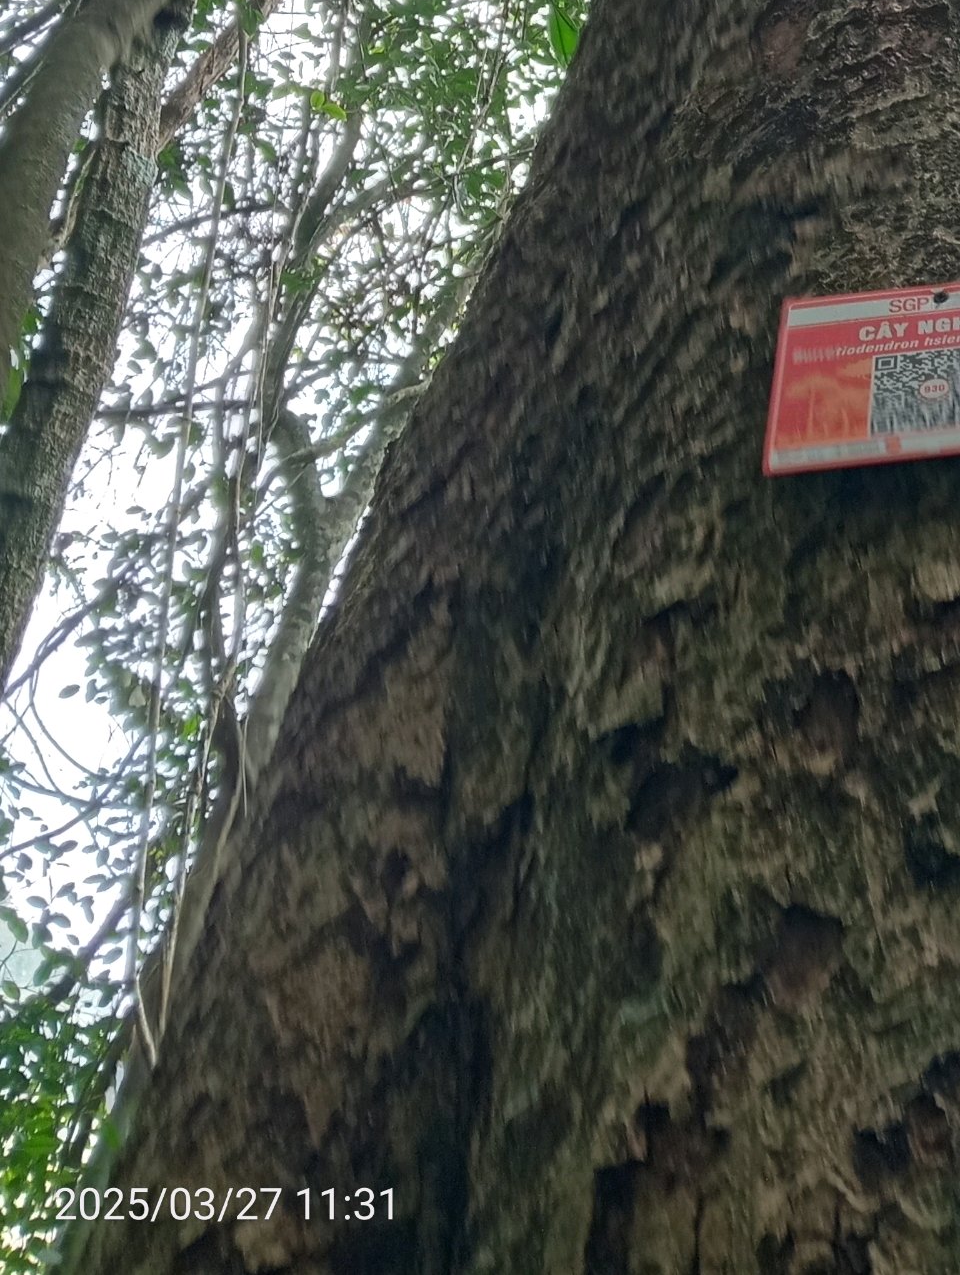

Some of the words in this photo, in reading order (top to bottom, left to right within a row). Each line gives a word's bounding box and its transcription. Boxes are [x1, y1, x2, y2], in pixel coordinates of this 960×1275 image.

[889, 297, 929, 313] SGP
[858, 321, 909, 341] CÂY
[792, 339, 919, 365] tiodendron
[924, 384, 945, 394] 930
